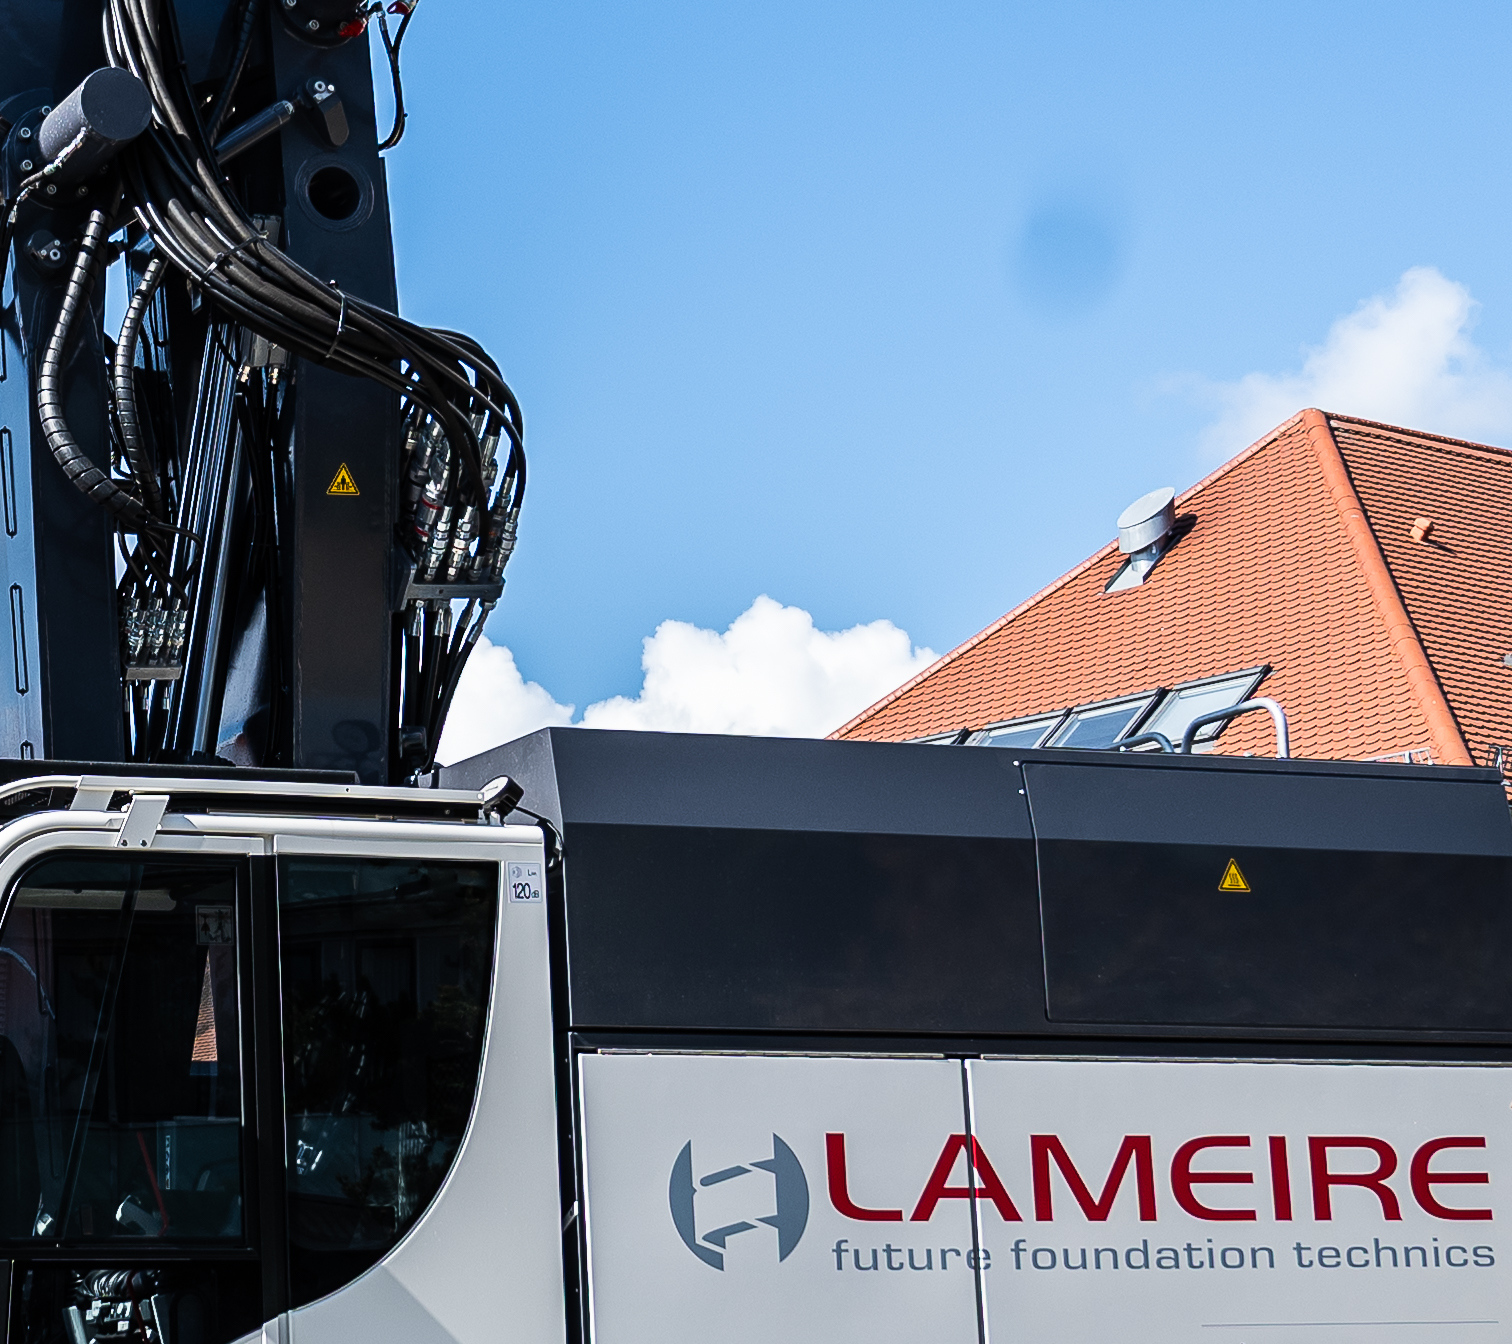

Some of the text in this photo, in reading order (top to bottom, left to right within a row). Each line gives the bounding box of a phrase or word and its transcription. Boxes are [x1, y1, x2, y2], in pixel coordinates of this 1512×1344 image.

[512, 883, 531, 899] 120
[825, 1133, 1494, 1222] LAMEIRE
[832, 1237, 1496, 1271] future foundation technics
